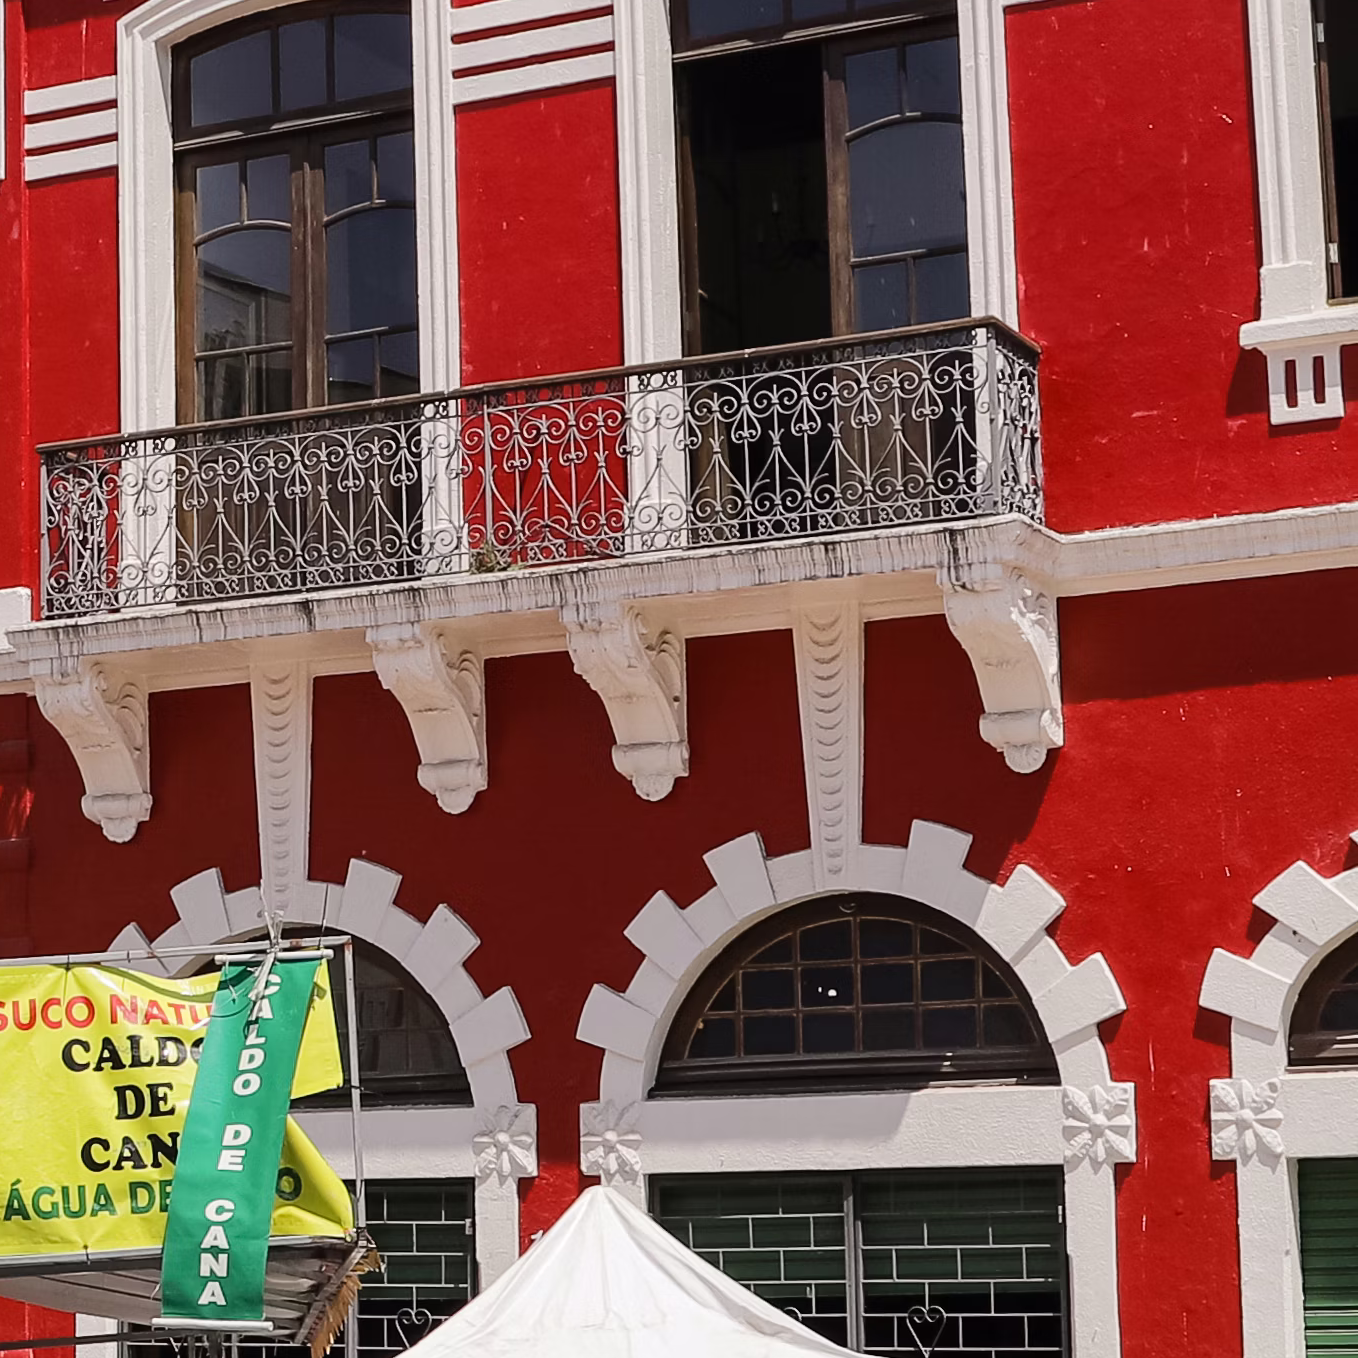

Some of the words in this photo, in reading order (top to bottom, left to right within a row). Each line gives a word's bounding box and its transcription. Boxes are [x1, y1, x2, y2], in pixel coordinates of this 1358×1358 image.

[113, 1082, 176, 1120] DE
[80, 1131, 181, 1173] CAN
[217, 1124, 252, 1171] DE
[3, 1177, 117, 1222] ÁGUA
[129, 1179, 173, 1214] DE
[198, 1199, 235, 1306] CANA
